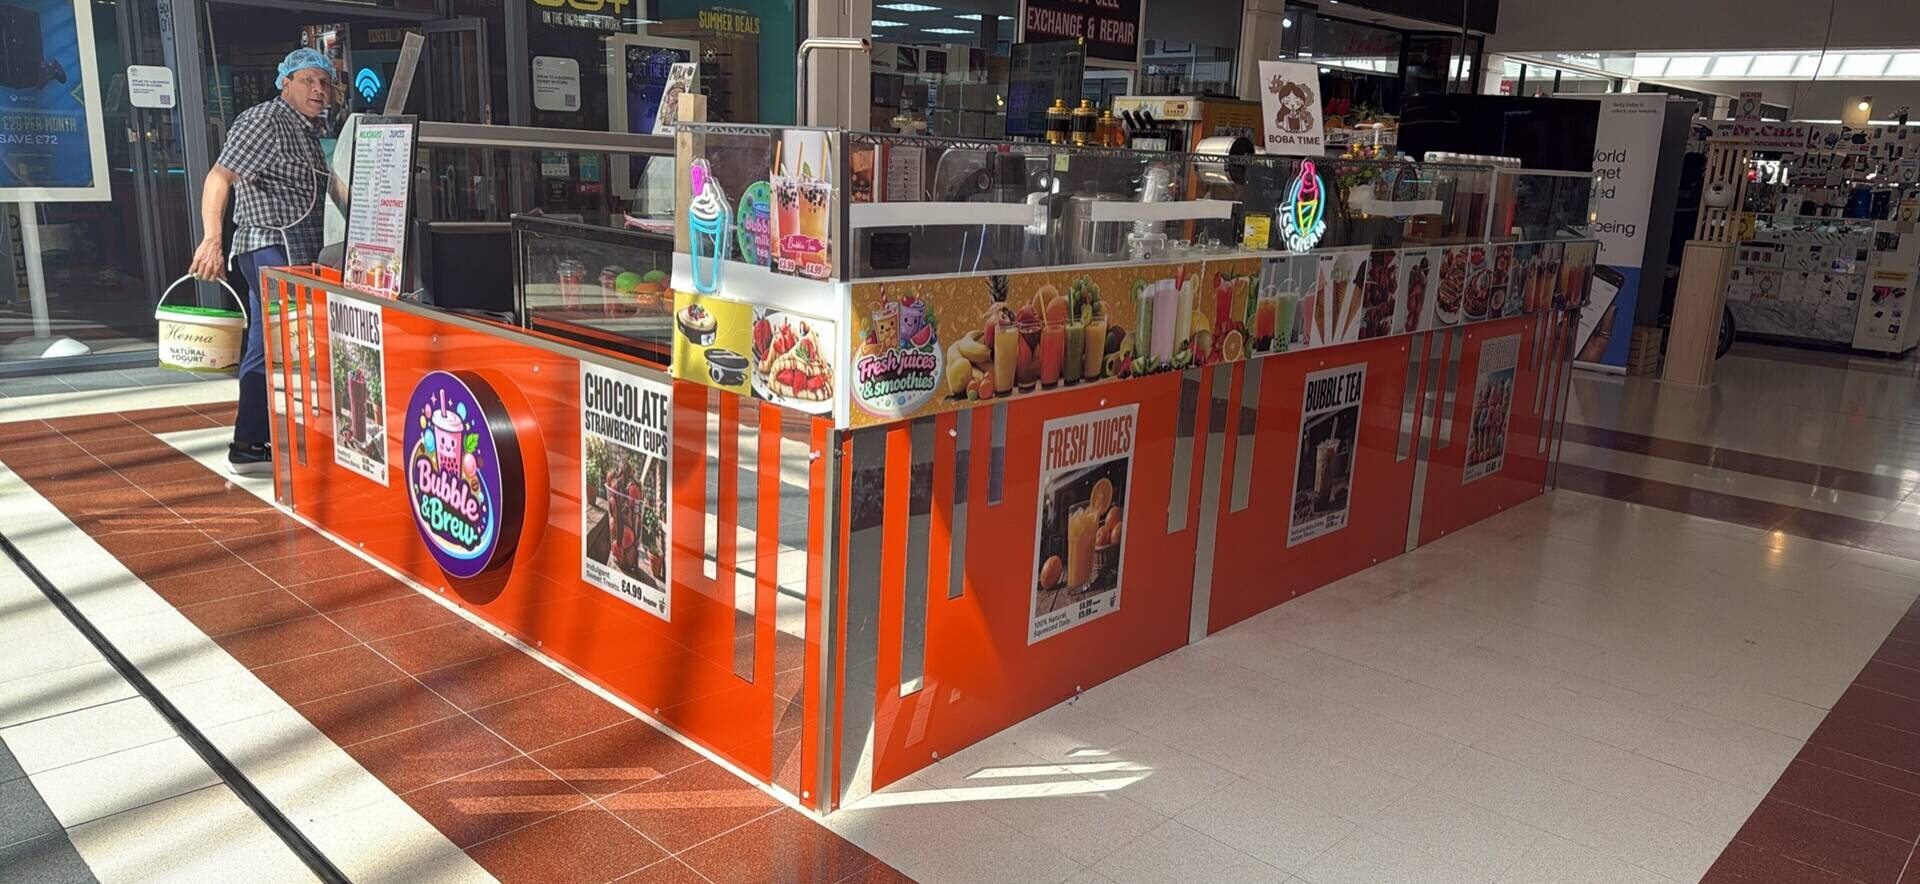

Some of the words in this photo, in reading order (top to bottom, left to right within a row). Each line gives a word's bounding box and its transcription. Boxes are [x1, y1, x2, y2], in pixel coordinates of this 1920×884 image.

[699, 10, 733, 31] SUMMER
[735, 15, 760, 34] DEALS
[1026, 7, 1083, 37] EXCHANGE
[1087, 17, 1095, 39] &
[1099, 19, 1135, 44] REPAIR
[44, 116, 77, 133] MONTH
[0, 133, 34, 144] SAVE
[36, 134, 59, 145] £72
[1268, 134, 1296, 144] BOBA
[1297, 136, 1321, 145] TIME
[1281, 205, 1296, 238] ICE
[1290, 219, 1327, 252] CREAM
[756, 247, 769, 258] tea
[780, 261, 796, 270] £3.99
[806, 265, 823, 274] £4.99
[165, 323, 217, 344] Henna
[329, 300, 380, 346] SMOOTHIES
[170, 347, 206, 357] NATURAL
[171, 354, 204, 364] YOGURT
[859, 349, 898, 382] Fresh
[897, 349, 936, 375] juices
[584, 371, 668, 433] CHOCOLATE
[1305, 375, 1345, 413] BUBBLE
[1345, 370, 1362, 403] TEA
[584, 409, 642, 448] STRAWBERRY
[643, 428, 668, 457] CUPS
[1045, 423, 1089, 472] FRESH
[1089, 414, 1133, 462] JUICES
[417, 458, 479, 522] Bubble
[621, 579, 643, 601] £4.99
